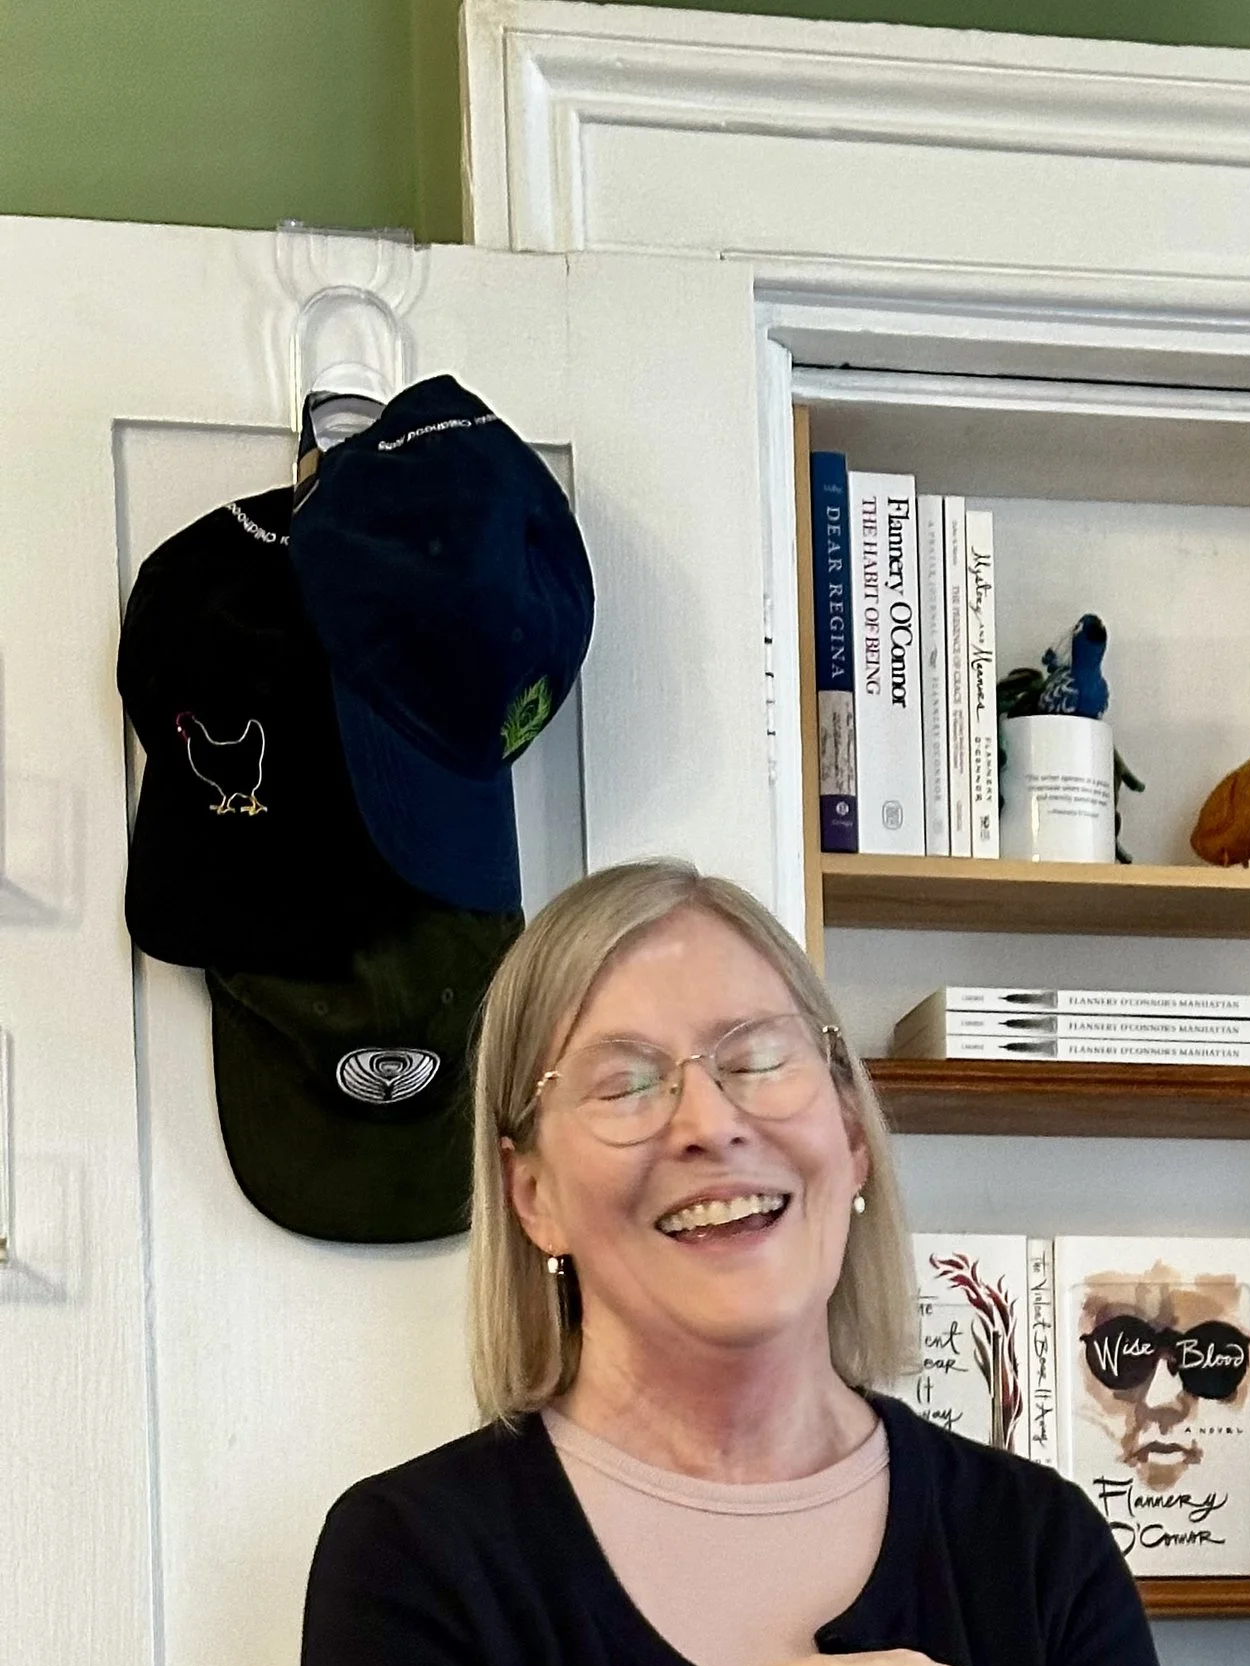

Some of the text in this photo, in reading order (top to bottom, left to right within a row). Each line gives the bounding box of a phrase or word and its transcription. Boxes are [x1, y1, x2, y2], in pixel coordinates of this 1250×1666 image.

[826, 506, 843, 573] DEAR
[828, 582, 845, 678] REGINA
[862, 497, 881, 695] THE HABIT OF BEING
[884, 497, 913, 708] Flannery O'Connor
[1093, 1331, 1245, 1377] Wise Blood
[1093, 1475, 1229, 1523] Flannery
